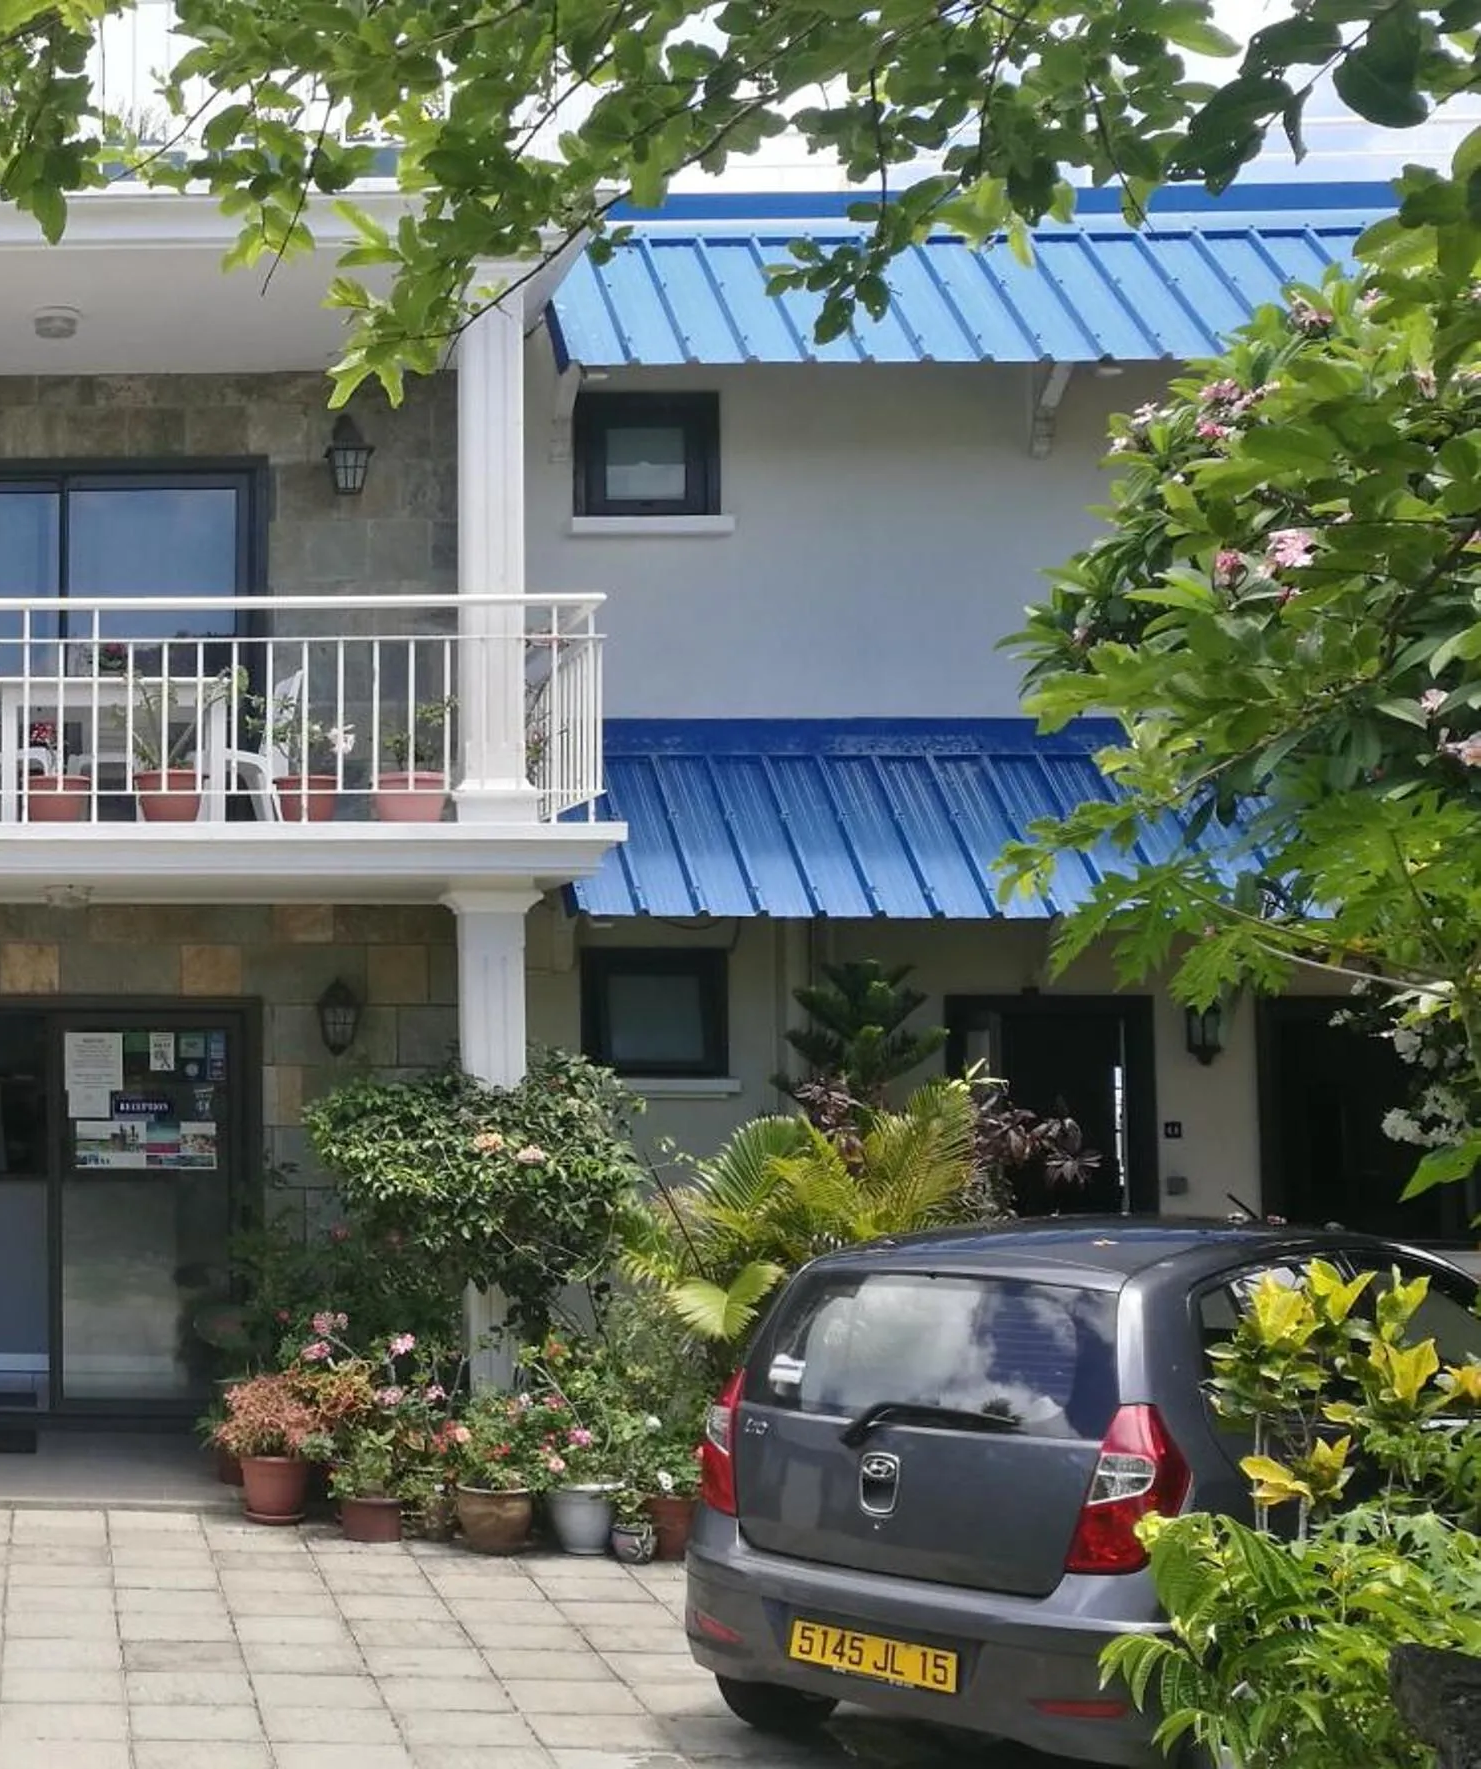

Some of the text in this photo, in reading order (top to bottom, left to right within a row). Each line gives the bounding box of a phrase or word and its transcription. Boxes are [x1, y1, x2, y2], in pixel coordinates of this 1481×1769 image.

[119, 1102, 169, 1112] RECEPTION
[799, 1626, 949, 1686] 5145 JL 15
